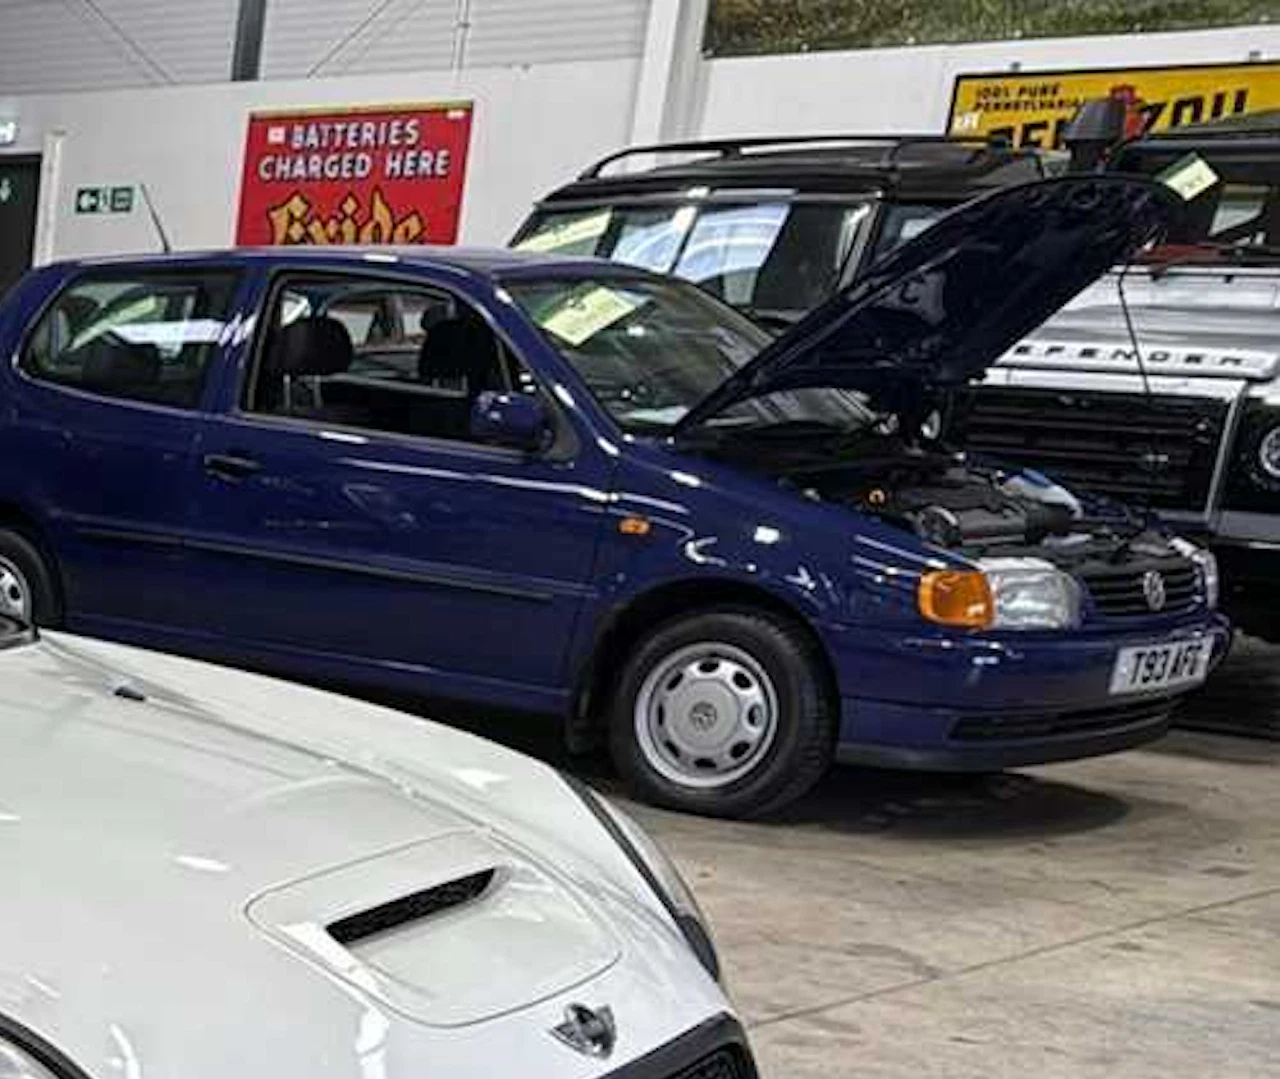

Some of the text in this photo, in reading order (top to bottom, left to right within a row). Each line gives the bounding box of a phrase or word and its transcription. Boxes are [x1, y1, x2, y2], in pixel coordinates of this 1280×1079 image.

[291, 119, 421, 150] BATTERIES
[258, 149, 451, 181] CHARGED HERE
[1129, 649, 1171, 684] T93
